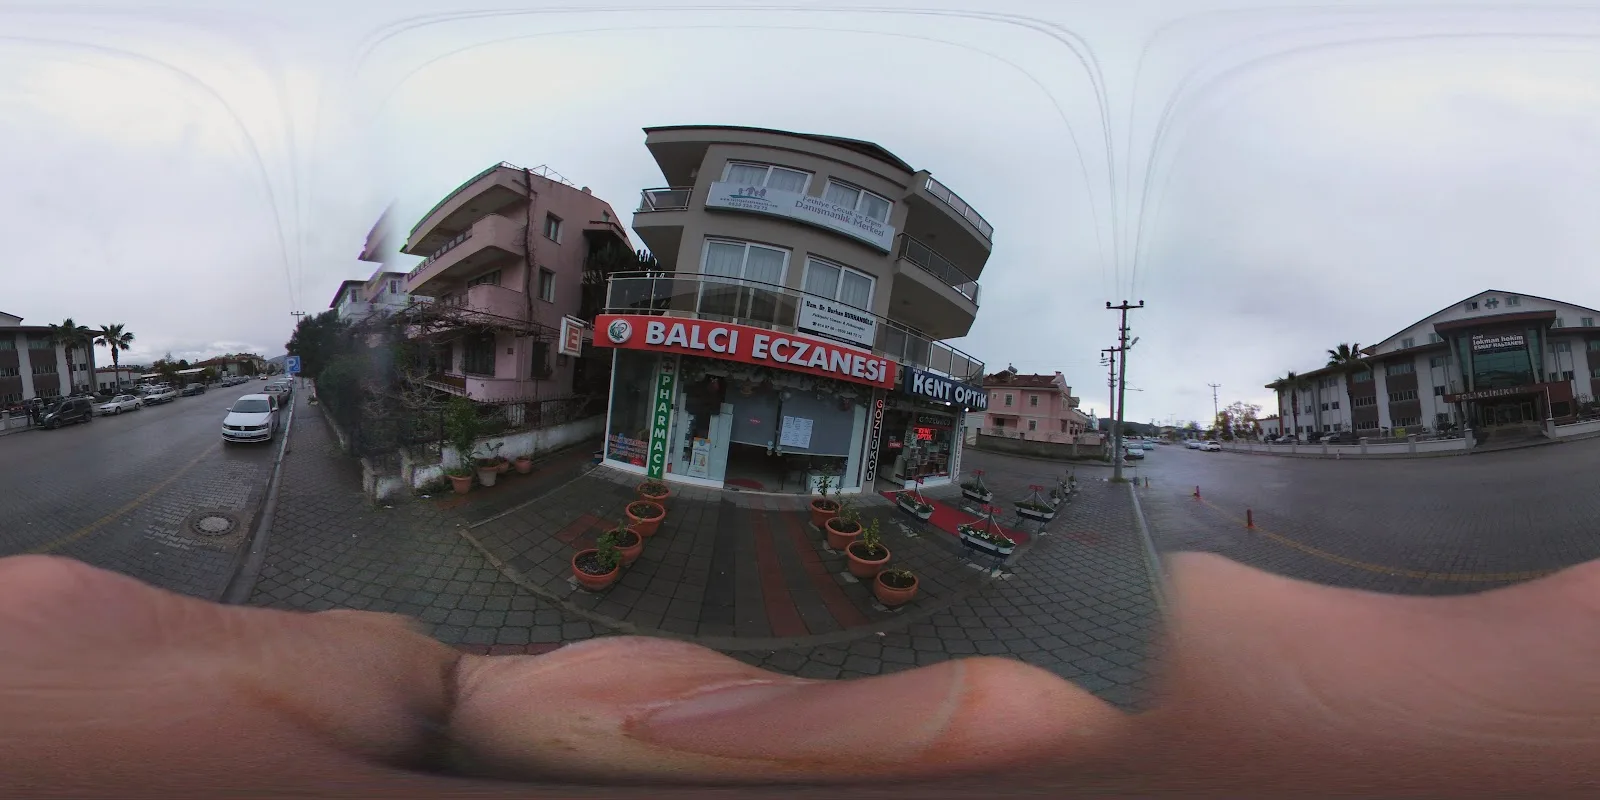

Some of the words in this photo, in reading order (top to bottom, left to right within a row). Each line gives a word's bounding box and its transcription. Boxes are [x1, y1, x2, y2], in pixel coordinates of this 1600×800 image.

[795, 201, 850, 223] Danışmanlık
[853, 218, 884, 237] Merkezi
[831, 203, 853, 217] Çocuk
[864, 216, 882, 228] Ergen
[827, 307, 843, 316] Burhan
[645, 321, 739, 356] BALCI
[751, 333, 888, 383] ECZANESİ
[1473, 337, 1499, 345] lokman
[286, 358, 296, 371] P
[912, 373, 952, 400] KENT
[954, 386, 988, 408] OPTİK
[652, 375, 671, 475] PHARMACY
